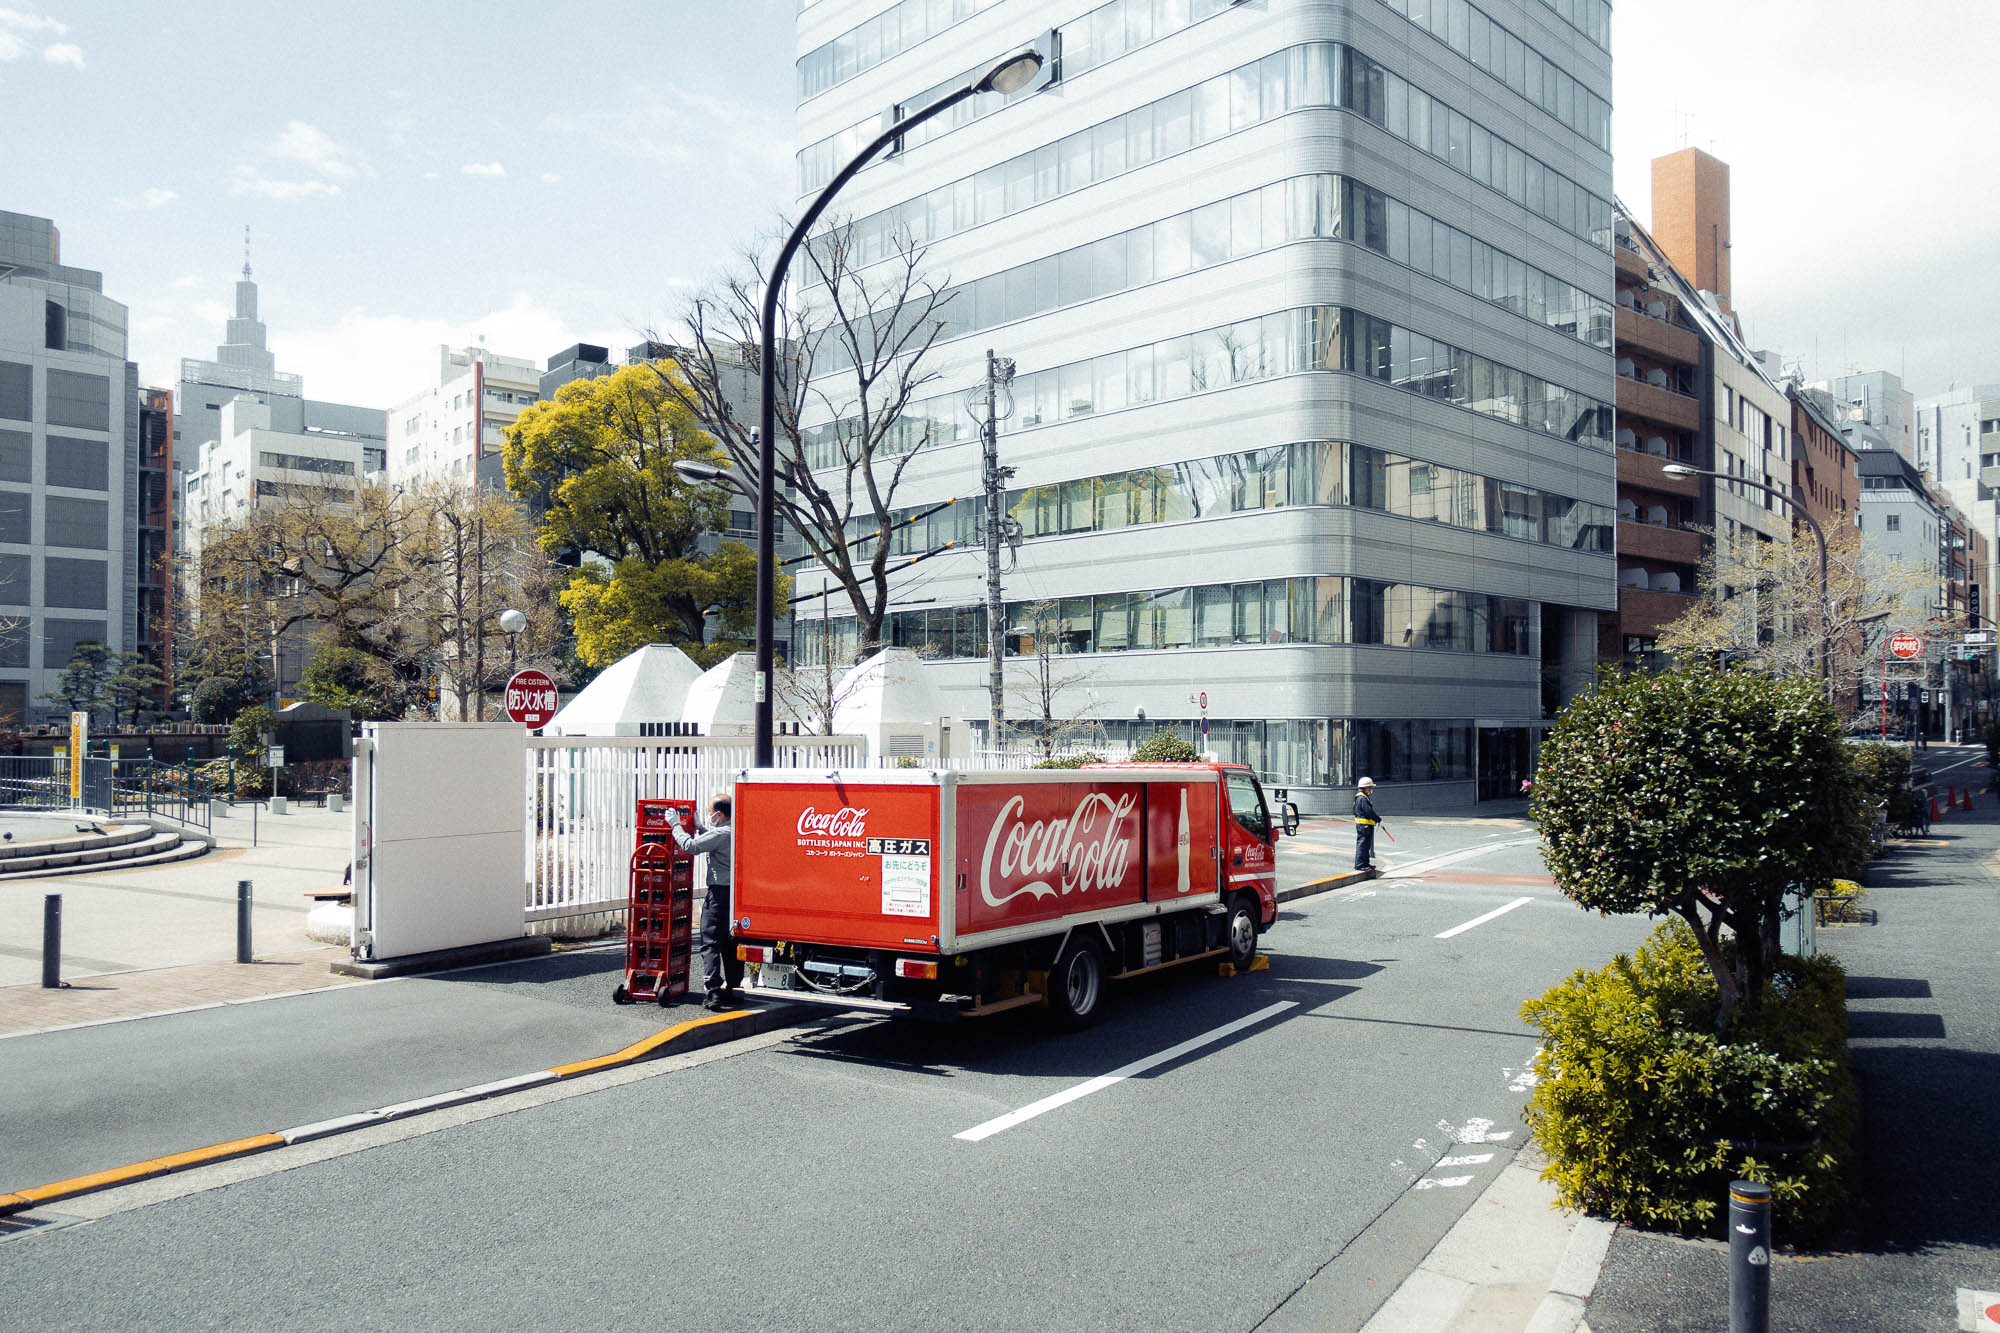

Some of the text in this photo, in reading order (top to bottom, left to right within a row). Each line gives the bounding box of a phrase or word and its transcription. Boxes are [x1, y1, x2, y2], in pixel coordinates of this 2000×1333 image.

[508, 689, 556, 711] 防火水槽
[797, 838, 831, 848] BOTTLERS
[831, 840, 852, 848] JAPAN
[868, 839, 928, 854] 高圧ガス
[884, 860, 927, 872] お先にどうぞ
